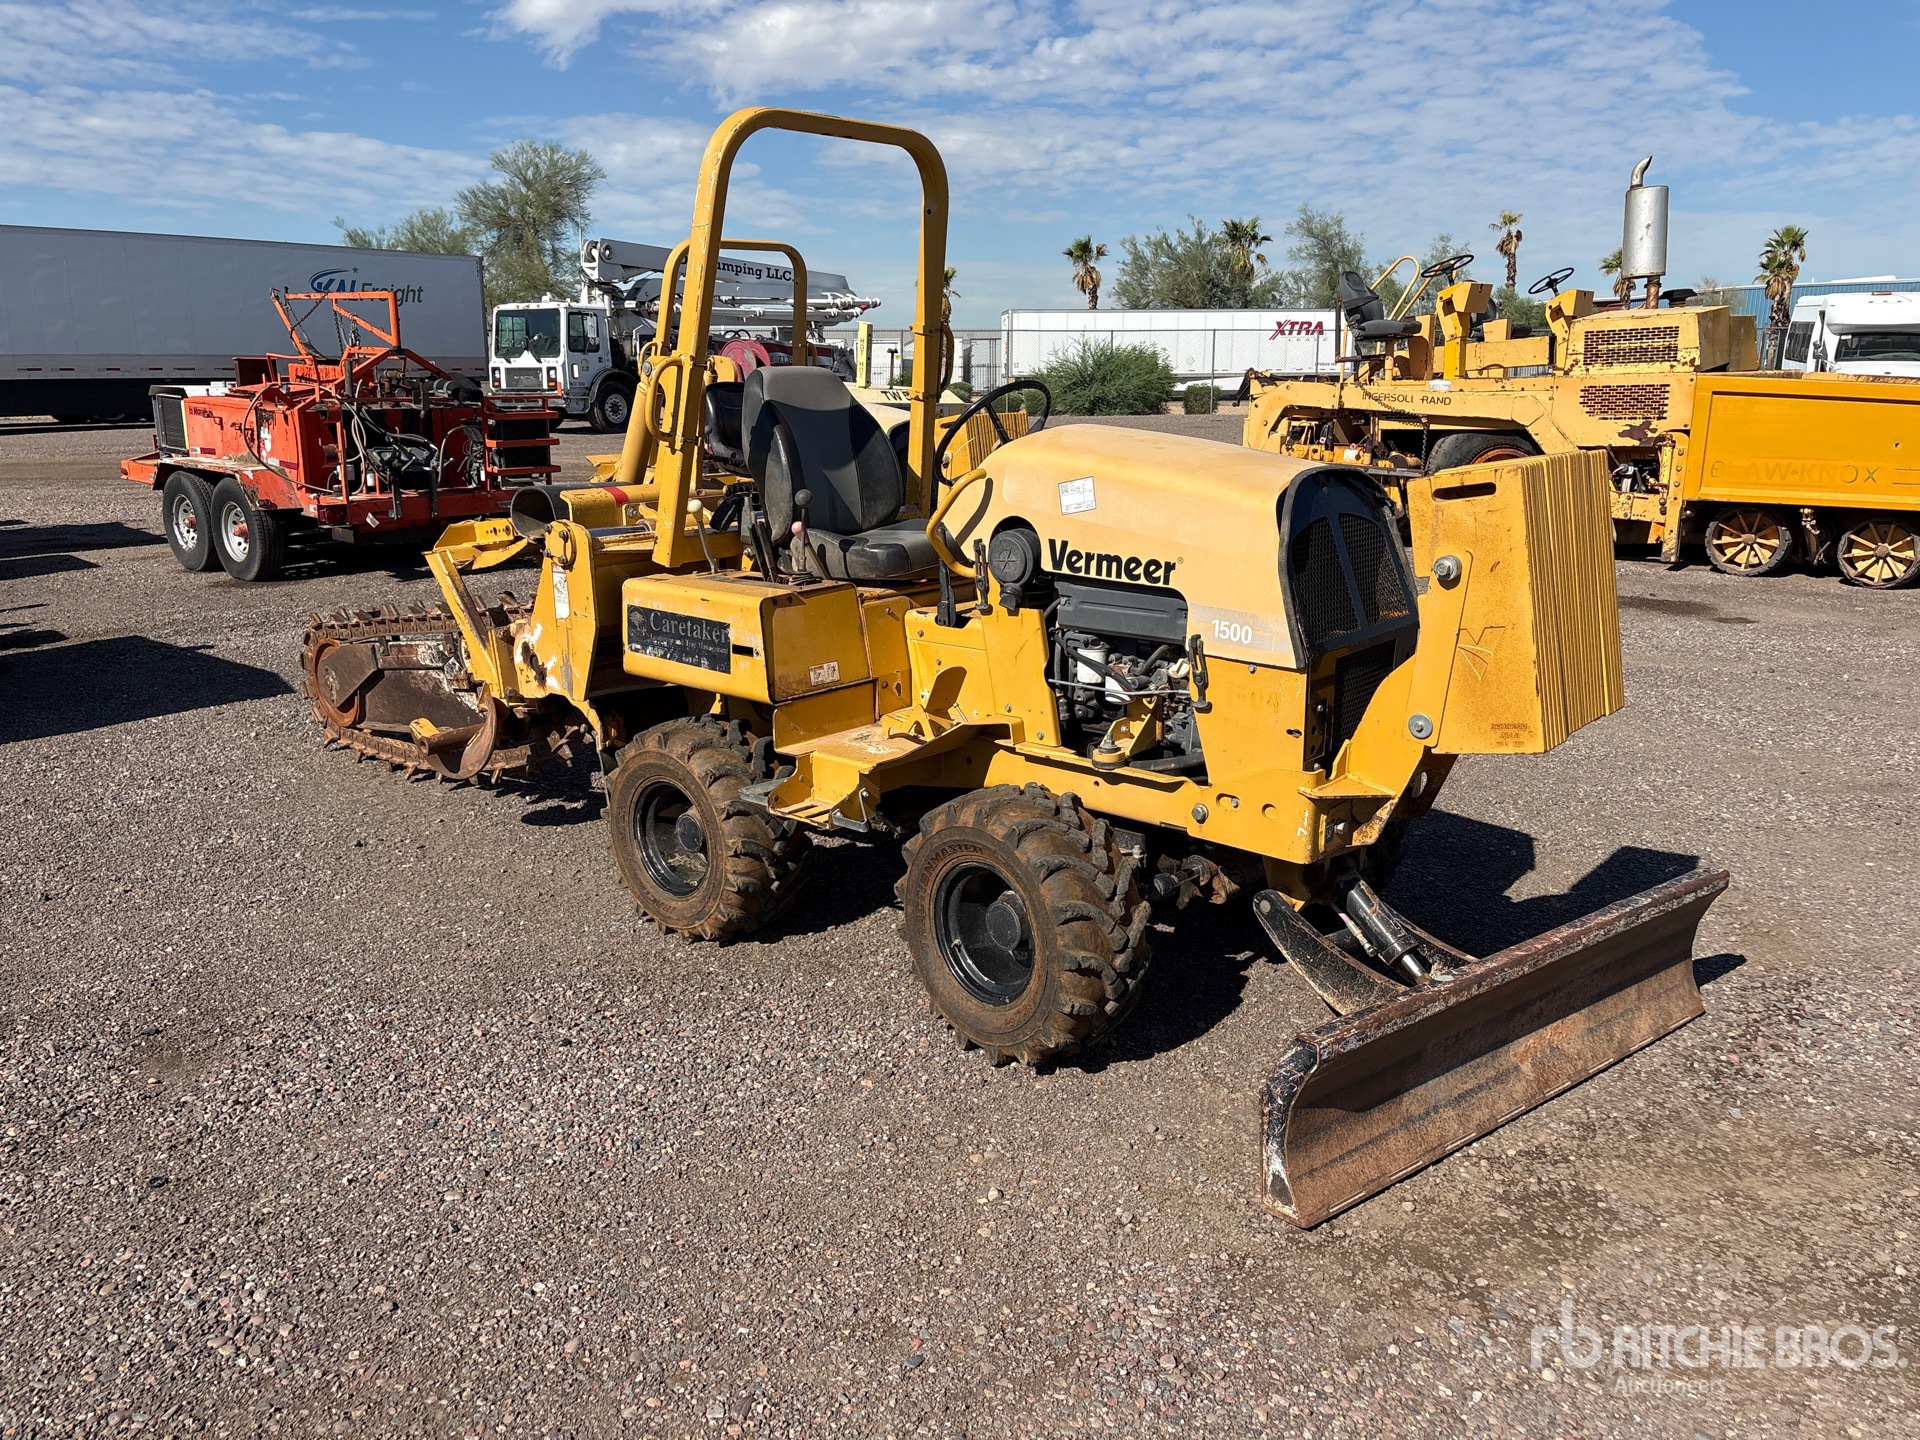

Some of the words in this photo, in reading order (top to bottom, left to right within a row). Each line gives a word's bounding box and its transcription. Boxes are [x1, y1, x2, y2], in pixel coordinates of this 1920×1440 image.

[1268, 319, 1325, 340] XTRA
[1048, 538, 1177, 586] Vermeer
[650, 611, 729, 643] Caretaker
[1211, 619, 1252, 645] 1500
